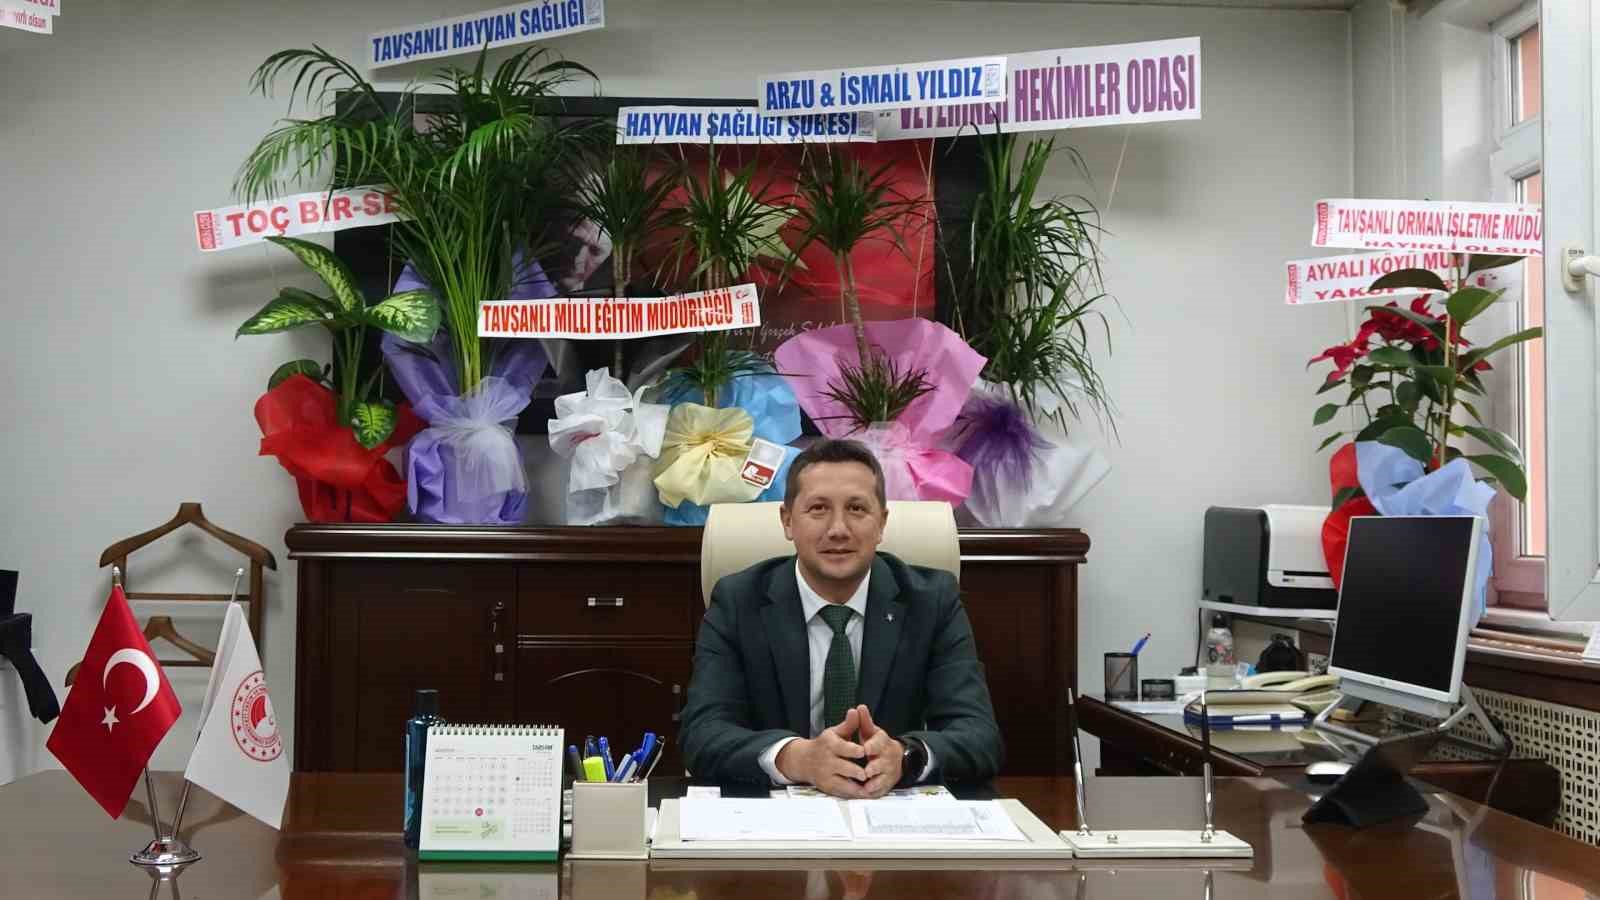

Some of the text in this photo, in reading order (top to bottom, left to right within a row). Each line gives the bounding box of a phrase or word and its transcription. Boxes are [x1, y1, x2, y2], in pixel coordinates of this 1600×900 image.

[373, 26, 448, 62] TAVŞANLI
[452, 12, 516, 48] HAYVAN
[766, 80, 815, 110] ARZU
[820, 83, 834, 107] &
[840, 68, 911, 106] İSMAİL
[917, 67, 982, 99] YILDIZ
[1014, 56, 1120, 123] HEKİMLER
[1127, 54, 1195, 115] ODASI
[627, 112, 700, 136] HAYVAN
[225, 206, 290, 237] TOÇ
[1338, 208, 1393, 240] TAVŞANLI
[1397, 210, 1443, 236] ORMAN
[1306, 260, 1364, 283] AYVALI
[482, 303, 551, 336] TAVŞANLI
[554, 297, 591, 333] MİLLİ
[594, 297, 643, 334] EĞİTİM
[647, 287, 734, 331] MÜDÜRLÜĞÜ
